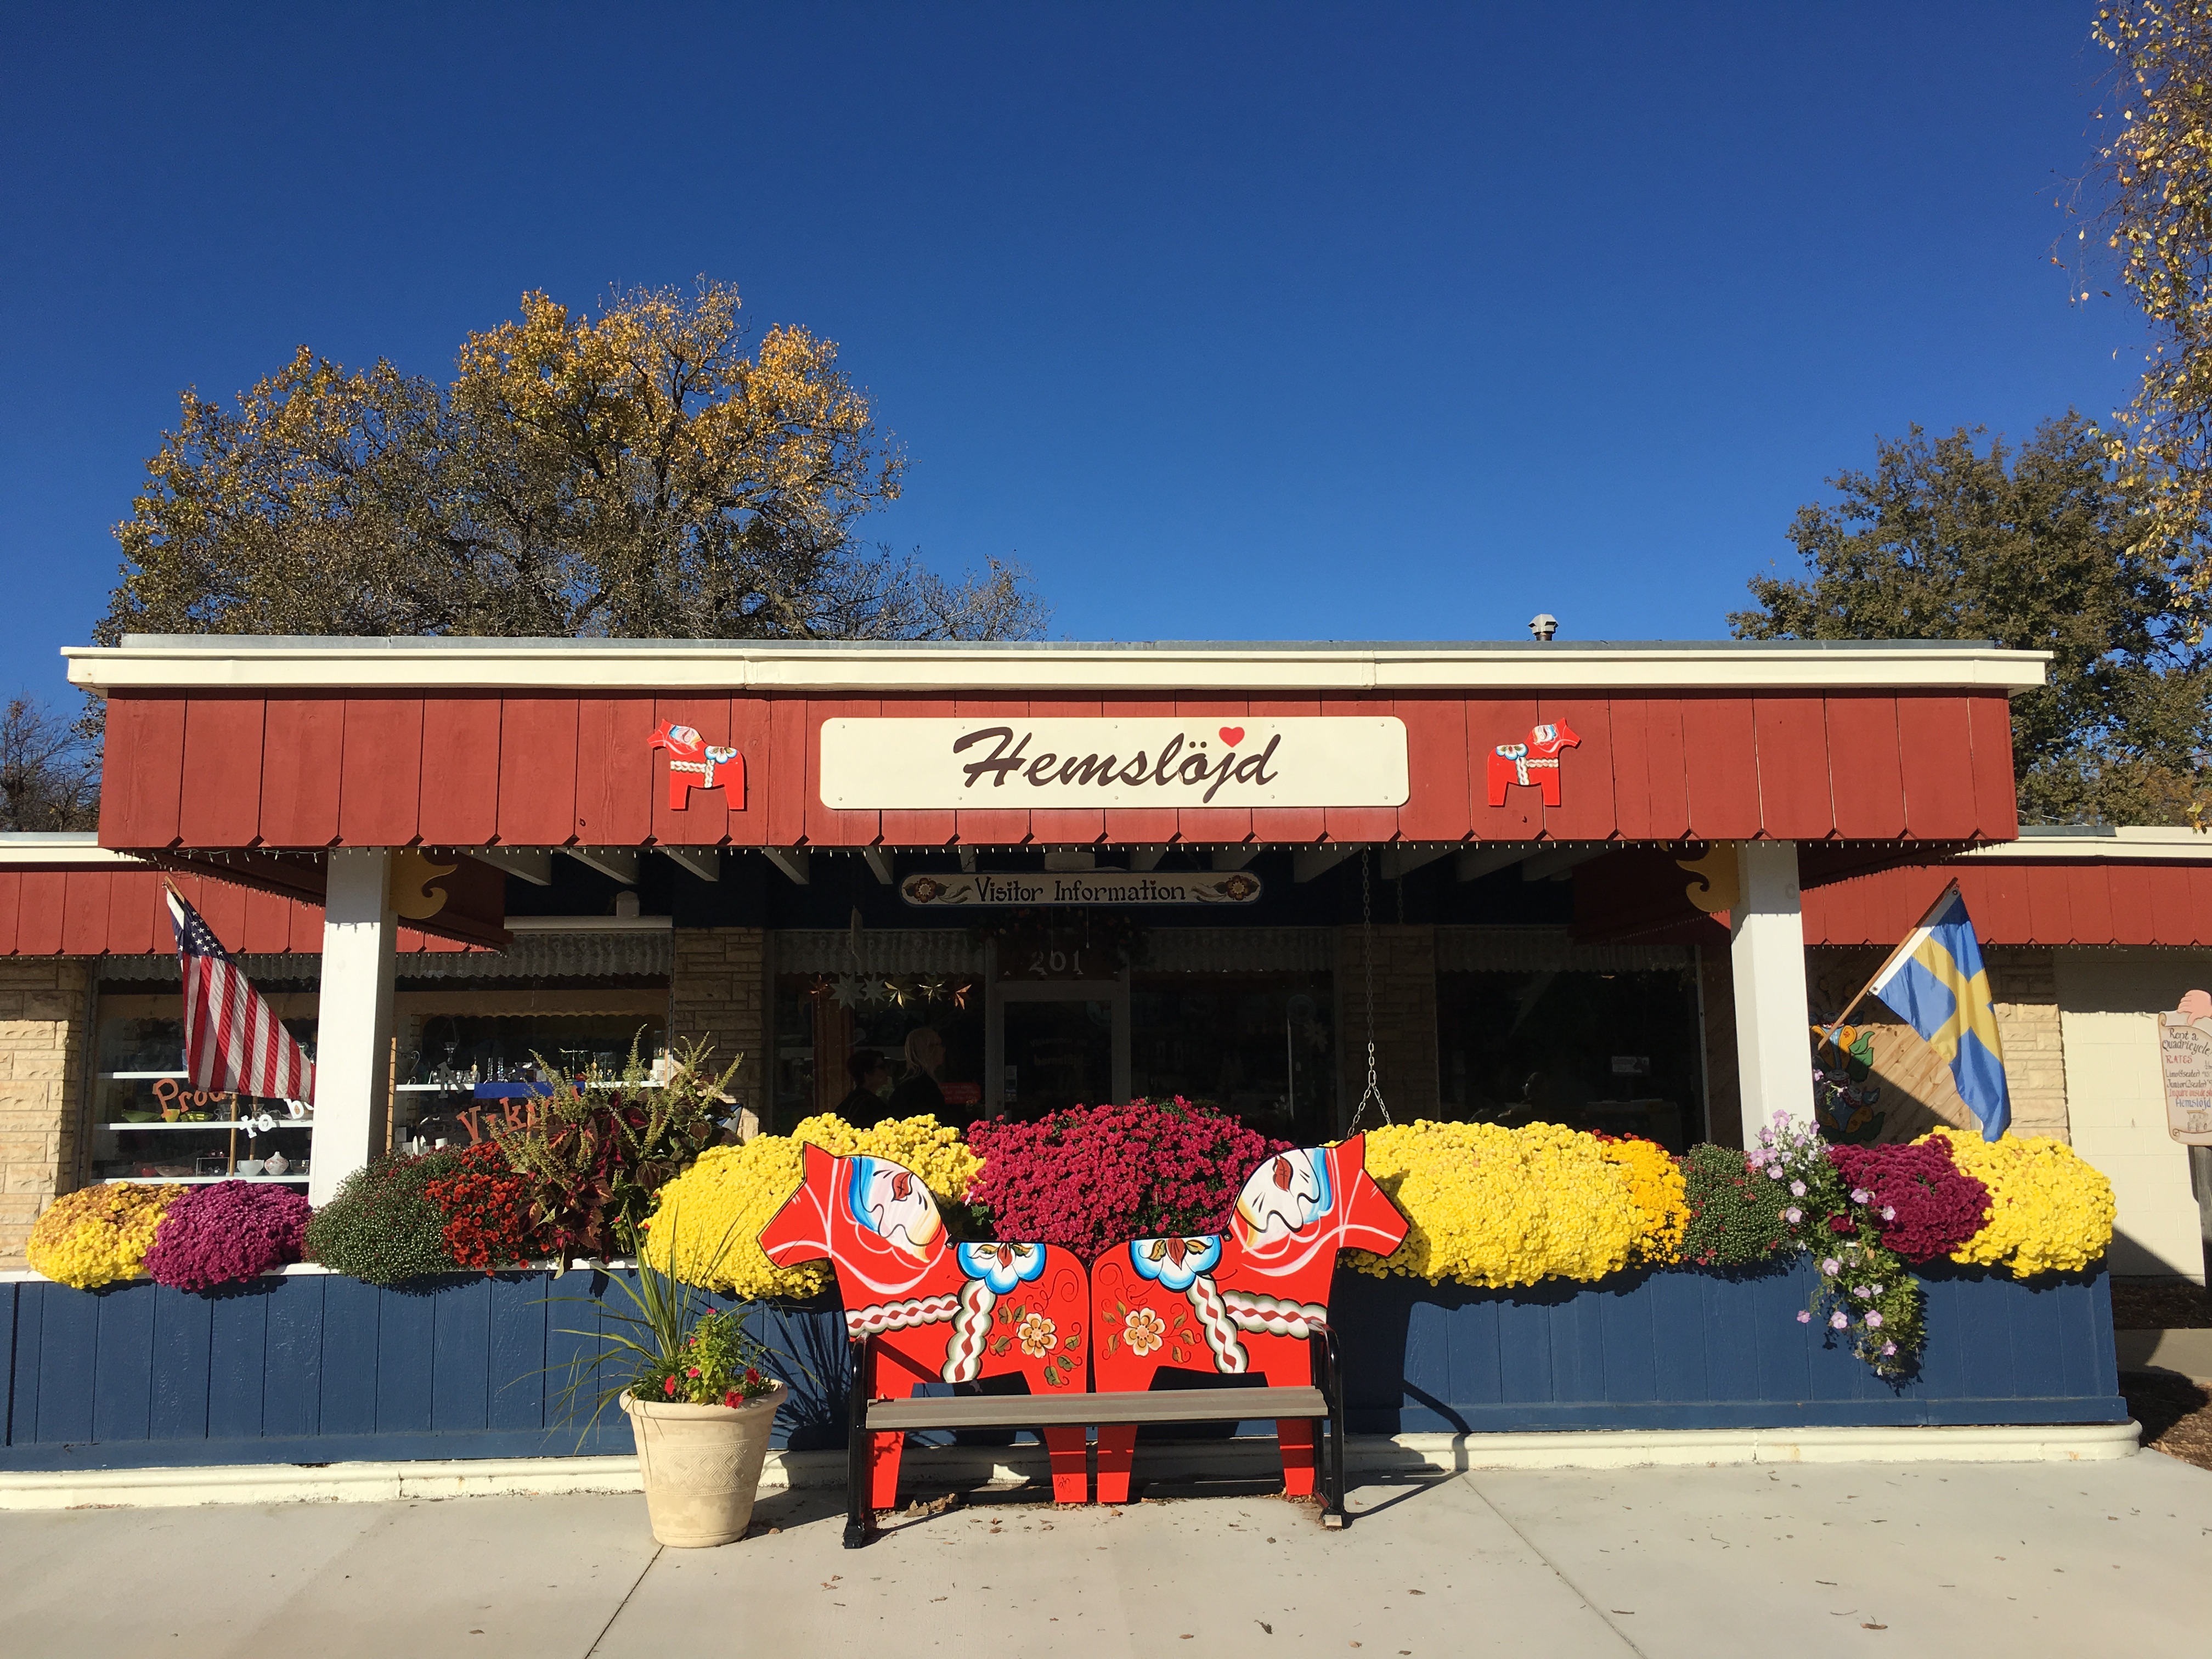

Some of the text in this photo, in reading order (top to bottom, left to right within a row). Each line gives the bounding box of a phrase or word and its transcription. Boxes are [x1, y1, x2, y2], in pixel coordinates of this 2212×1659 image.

[953, 726, 1281, 803] Hemslöjd
[975, 877, 1186, 902] Visitor Information
[1028, 950, 1082, 973] 201
[2168, 1027, 2199, 1041] Rent a
[2165, 1054, 2193, 1064] RATES
[437, 1061, 467, 1098] A
[153, 1078, 226, 1119] Prou
[2169, 1088, 2188, 1099] Inquire
[2175, 1097, 2211, 1111] Hemslöjd
[239, 1114, 274, 1138] to
